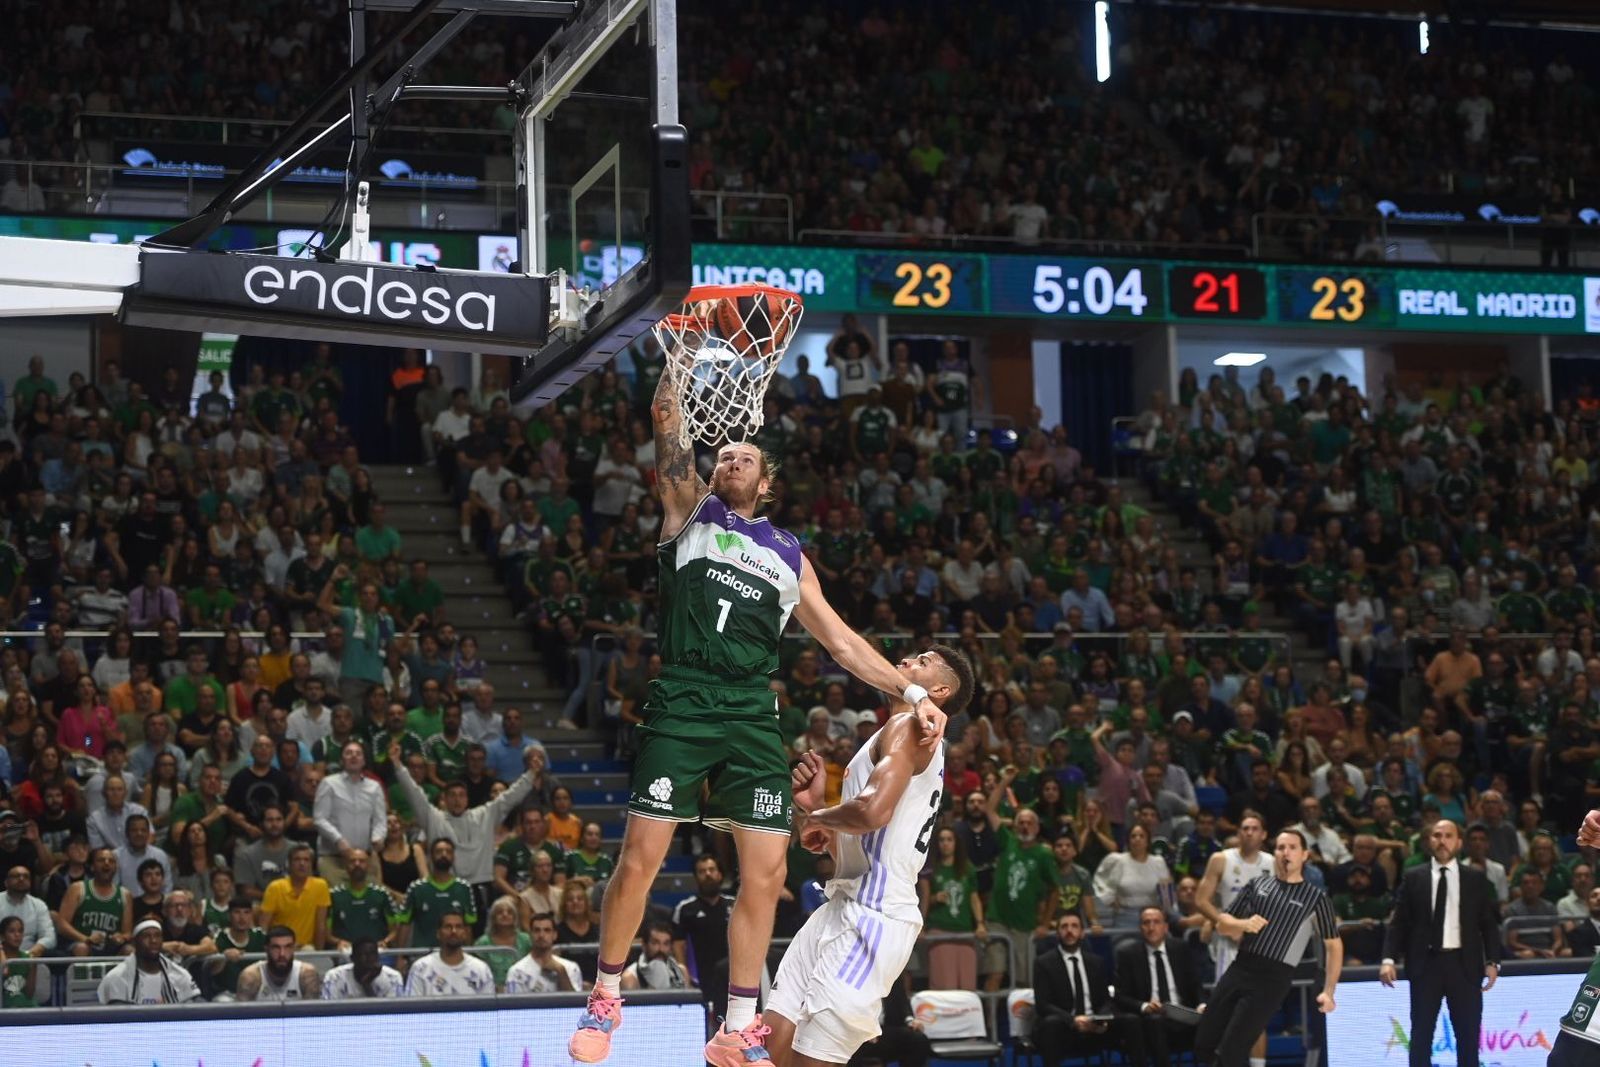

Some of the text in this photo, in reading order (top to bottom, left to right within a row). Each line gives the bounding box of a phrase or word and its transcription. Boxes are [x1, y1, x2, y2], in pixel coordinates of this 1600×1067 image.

[243, 264, 496, 332] endesa
[692, 264, 825, 295] UNICAJA
[893, 262, 953, 308] 23
[1033, 265, 1148, 316] 5:04
[1193, 271, 1240, 313] 21
[1309, 277, 1365, 322] 23
[1399, 289, 1576, 319] REAL MADRID
[740, 552, 781, 581] Unicaja
[716, 598, 733, 633] 1
